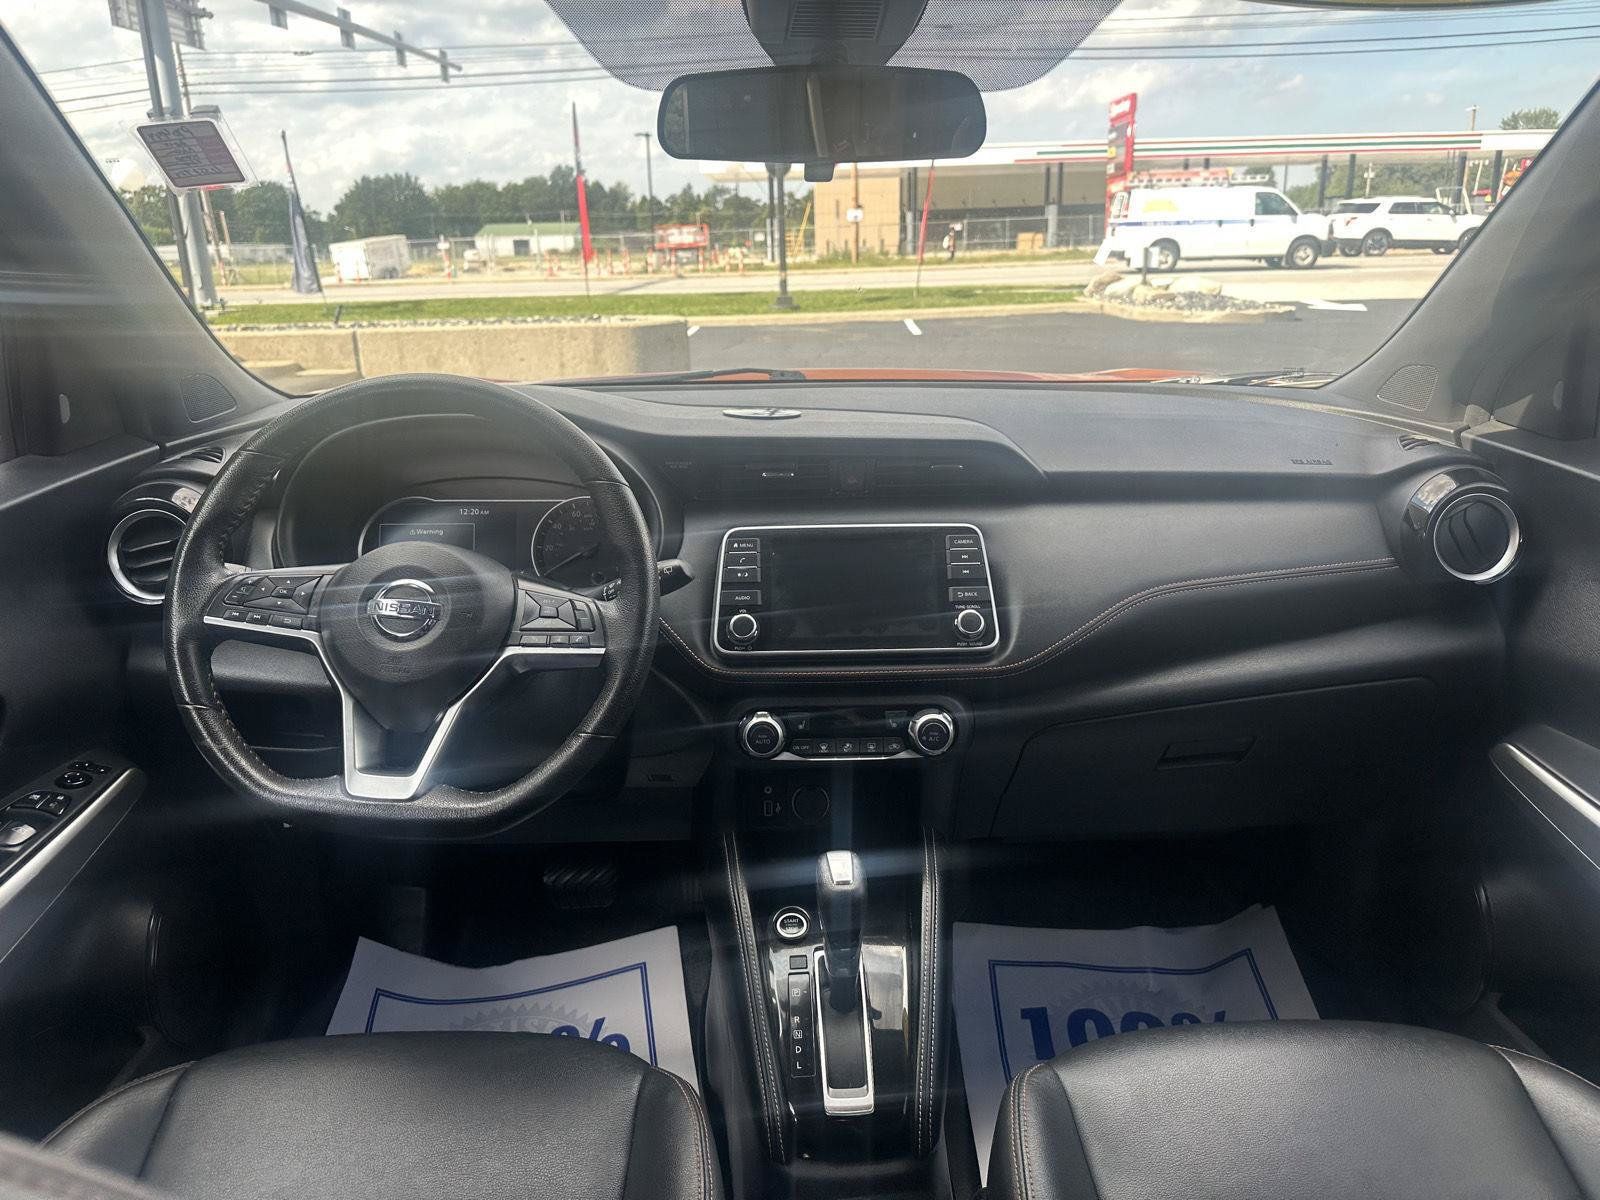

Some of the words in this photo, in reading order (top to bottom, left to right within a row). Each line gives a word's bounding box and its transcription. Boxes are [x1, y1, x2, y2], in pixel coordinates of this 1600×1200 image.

[459, 508, 480, 516] 12:20
[416, 528, 444, 537] Warning
[373, 602, 436, 617] NISSAN
[796, 1061, 802, 1069] L
